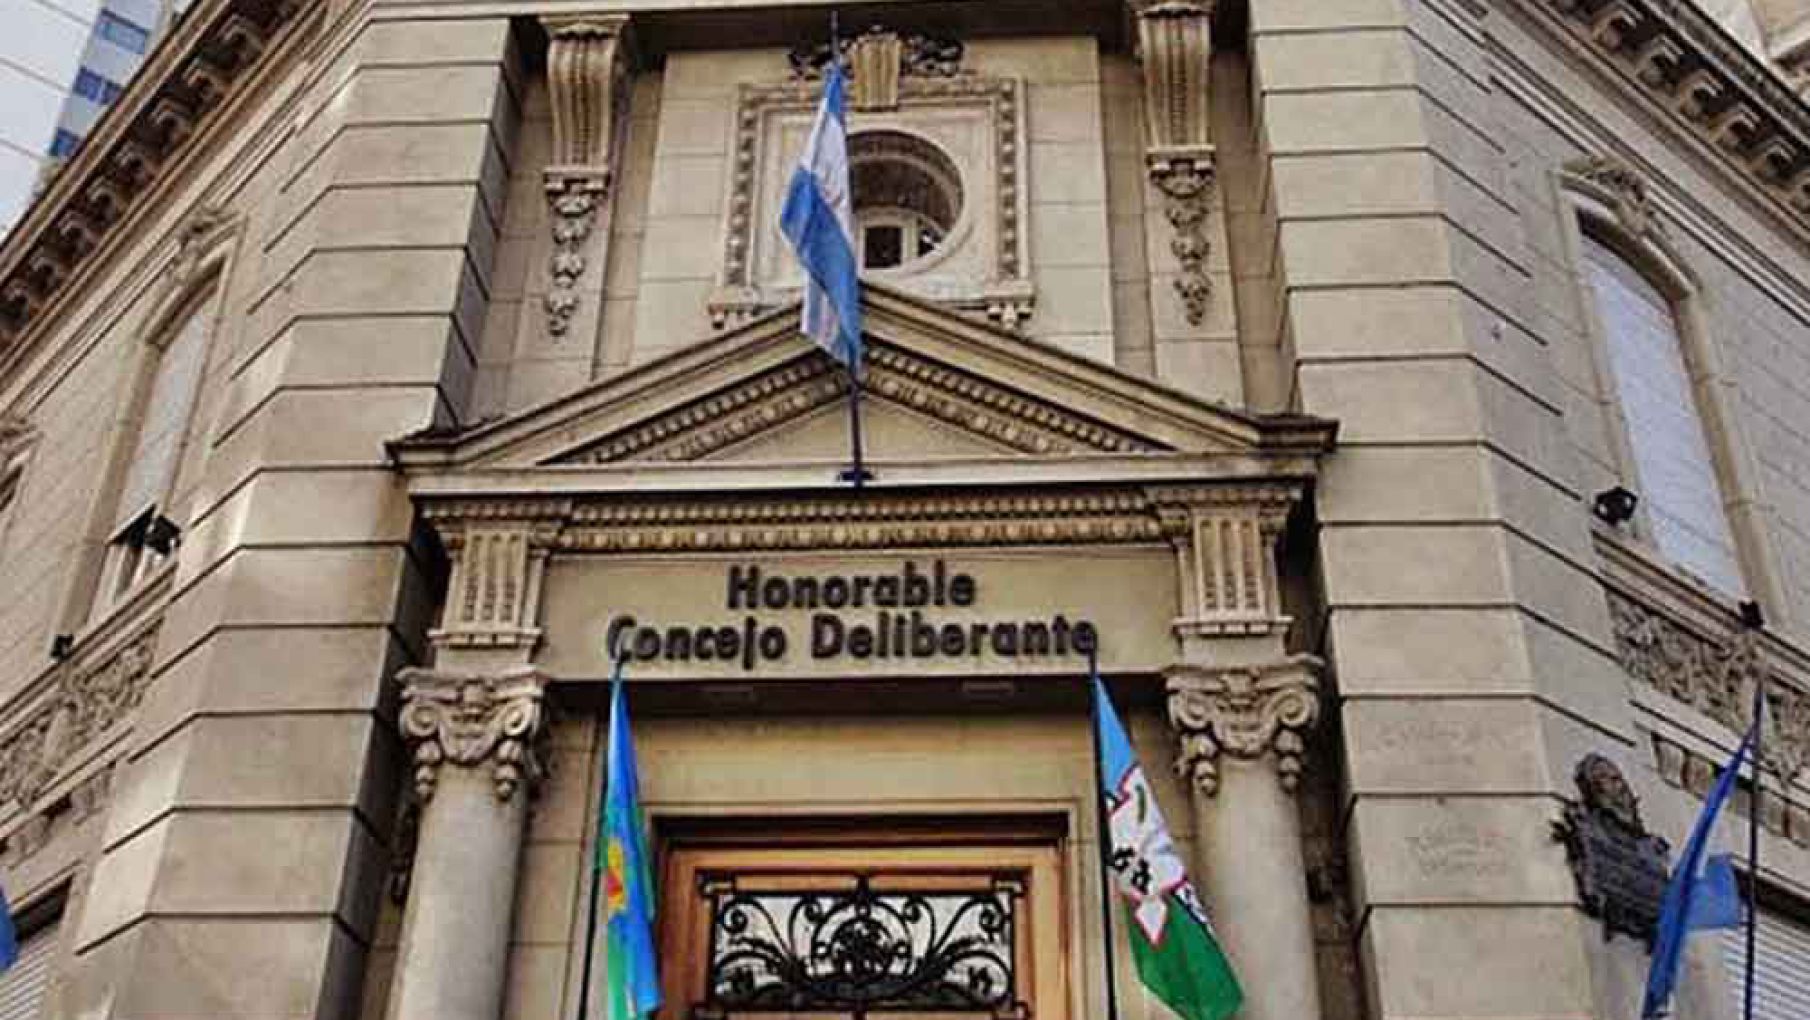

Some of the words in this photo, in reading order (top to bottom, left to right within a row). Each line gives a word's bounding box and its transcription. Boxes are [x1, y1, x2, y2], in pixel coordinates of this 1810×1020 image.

[727, 561, 977, 610] Honorable
[607, 615, 787, 670] Concejo
[811, 611, 1098, 659] Deliberante
